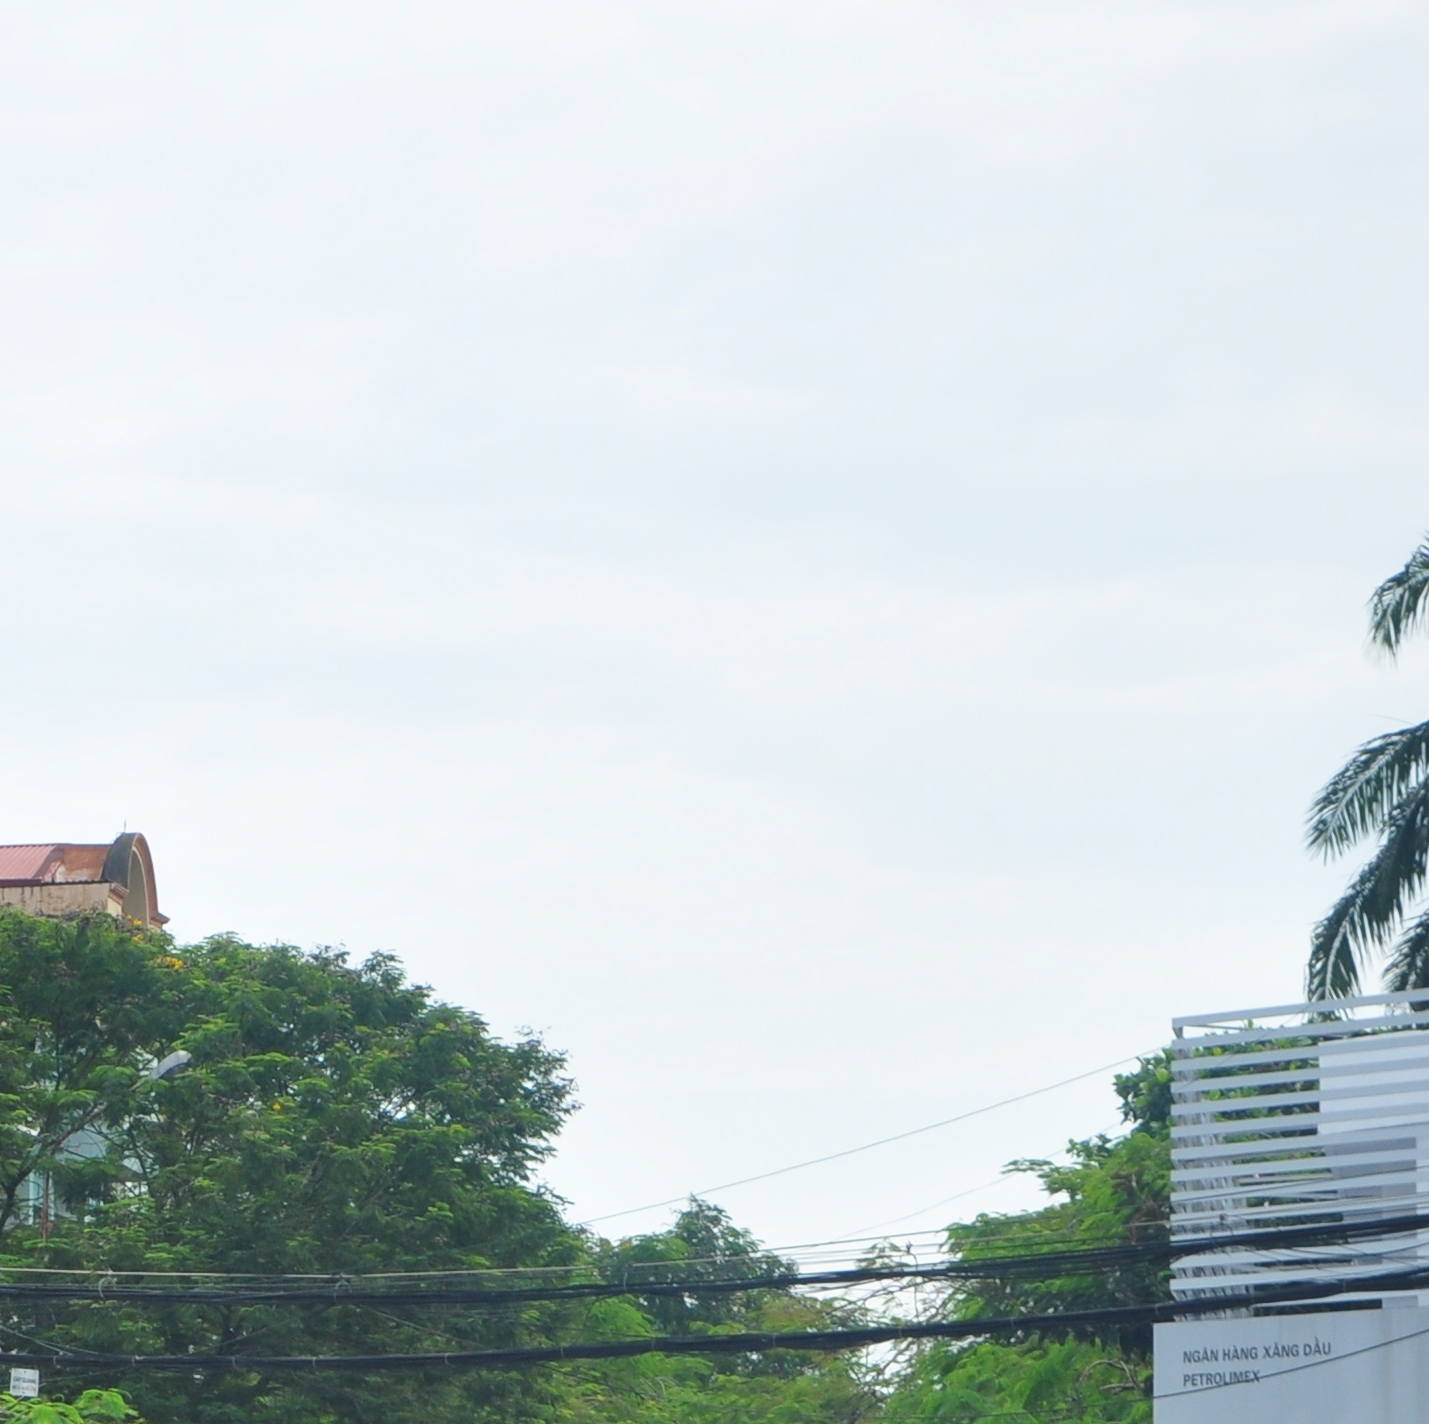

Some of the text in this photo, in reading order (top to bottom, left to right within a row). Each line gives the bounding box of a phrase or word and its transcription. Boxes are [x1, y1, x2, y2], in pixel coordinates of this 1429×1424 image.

[1183, 1337, 1331, 1363] NGÂN HÀNG XĂNG DẦU
[1183, 1370, 1260, 1387] PETROLIMEX
